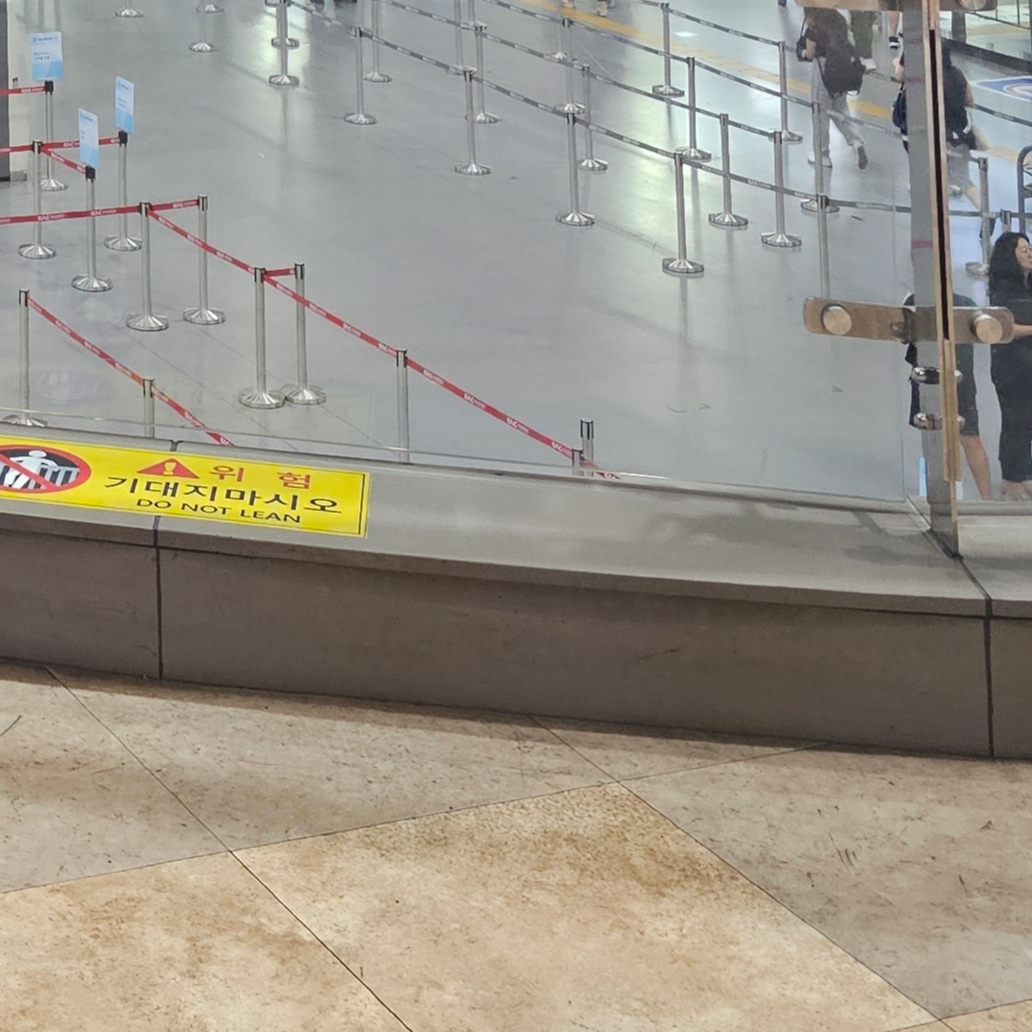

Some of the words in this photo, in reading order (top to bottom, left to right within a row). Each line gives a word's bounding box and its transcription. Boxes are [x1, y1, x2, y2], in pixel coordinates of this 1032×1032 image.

[209, 465, 245, 483] 위
[277, 471, 311, 490] 험
[104, 476, 343, 514] 기대지마시오
[136, 498, 172, 509] DO
[180, 502, 233, 516] NOT
[239, 508, 301, 524] LEAN
